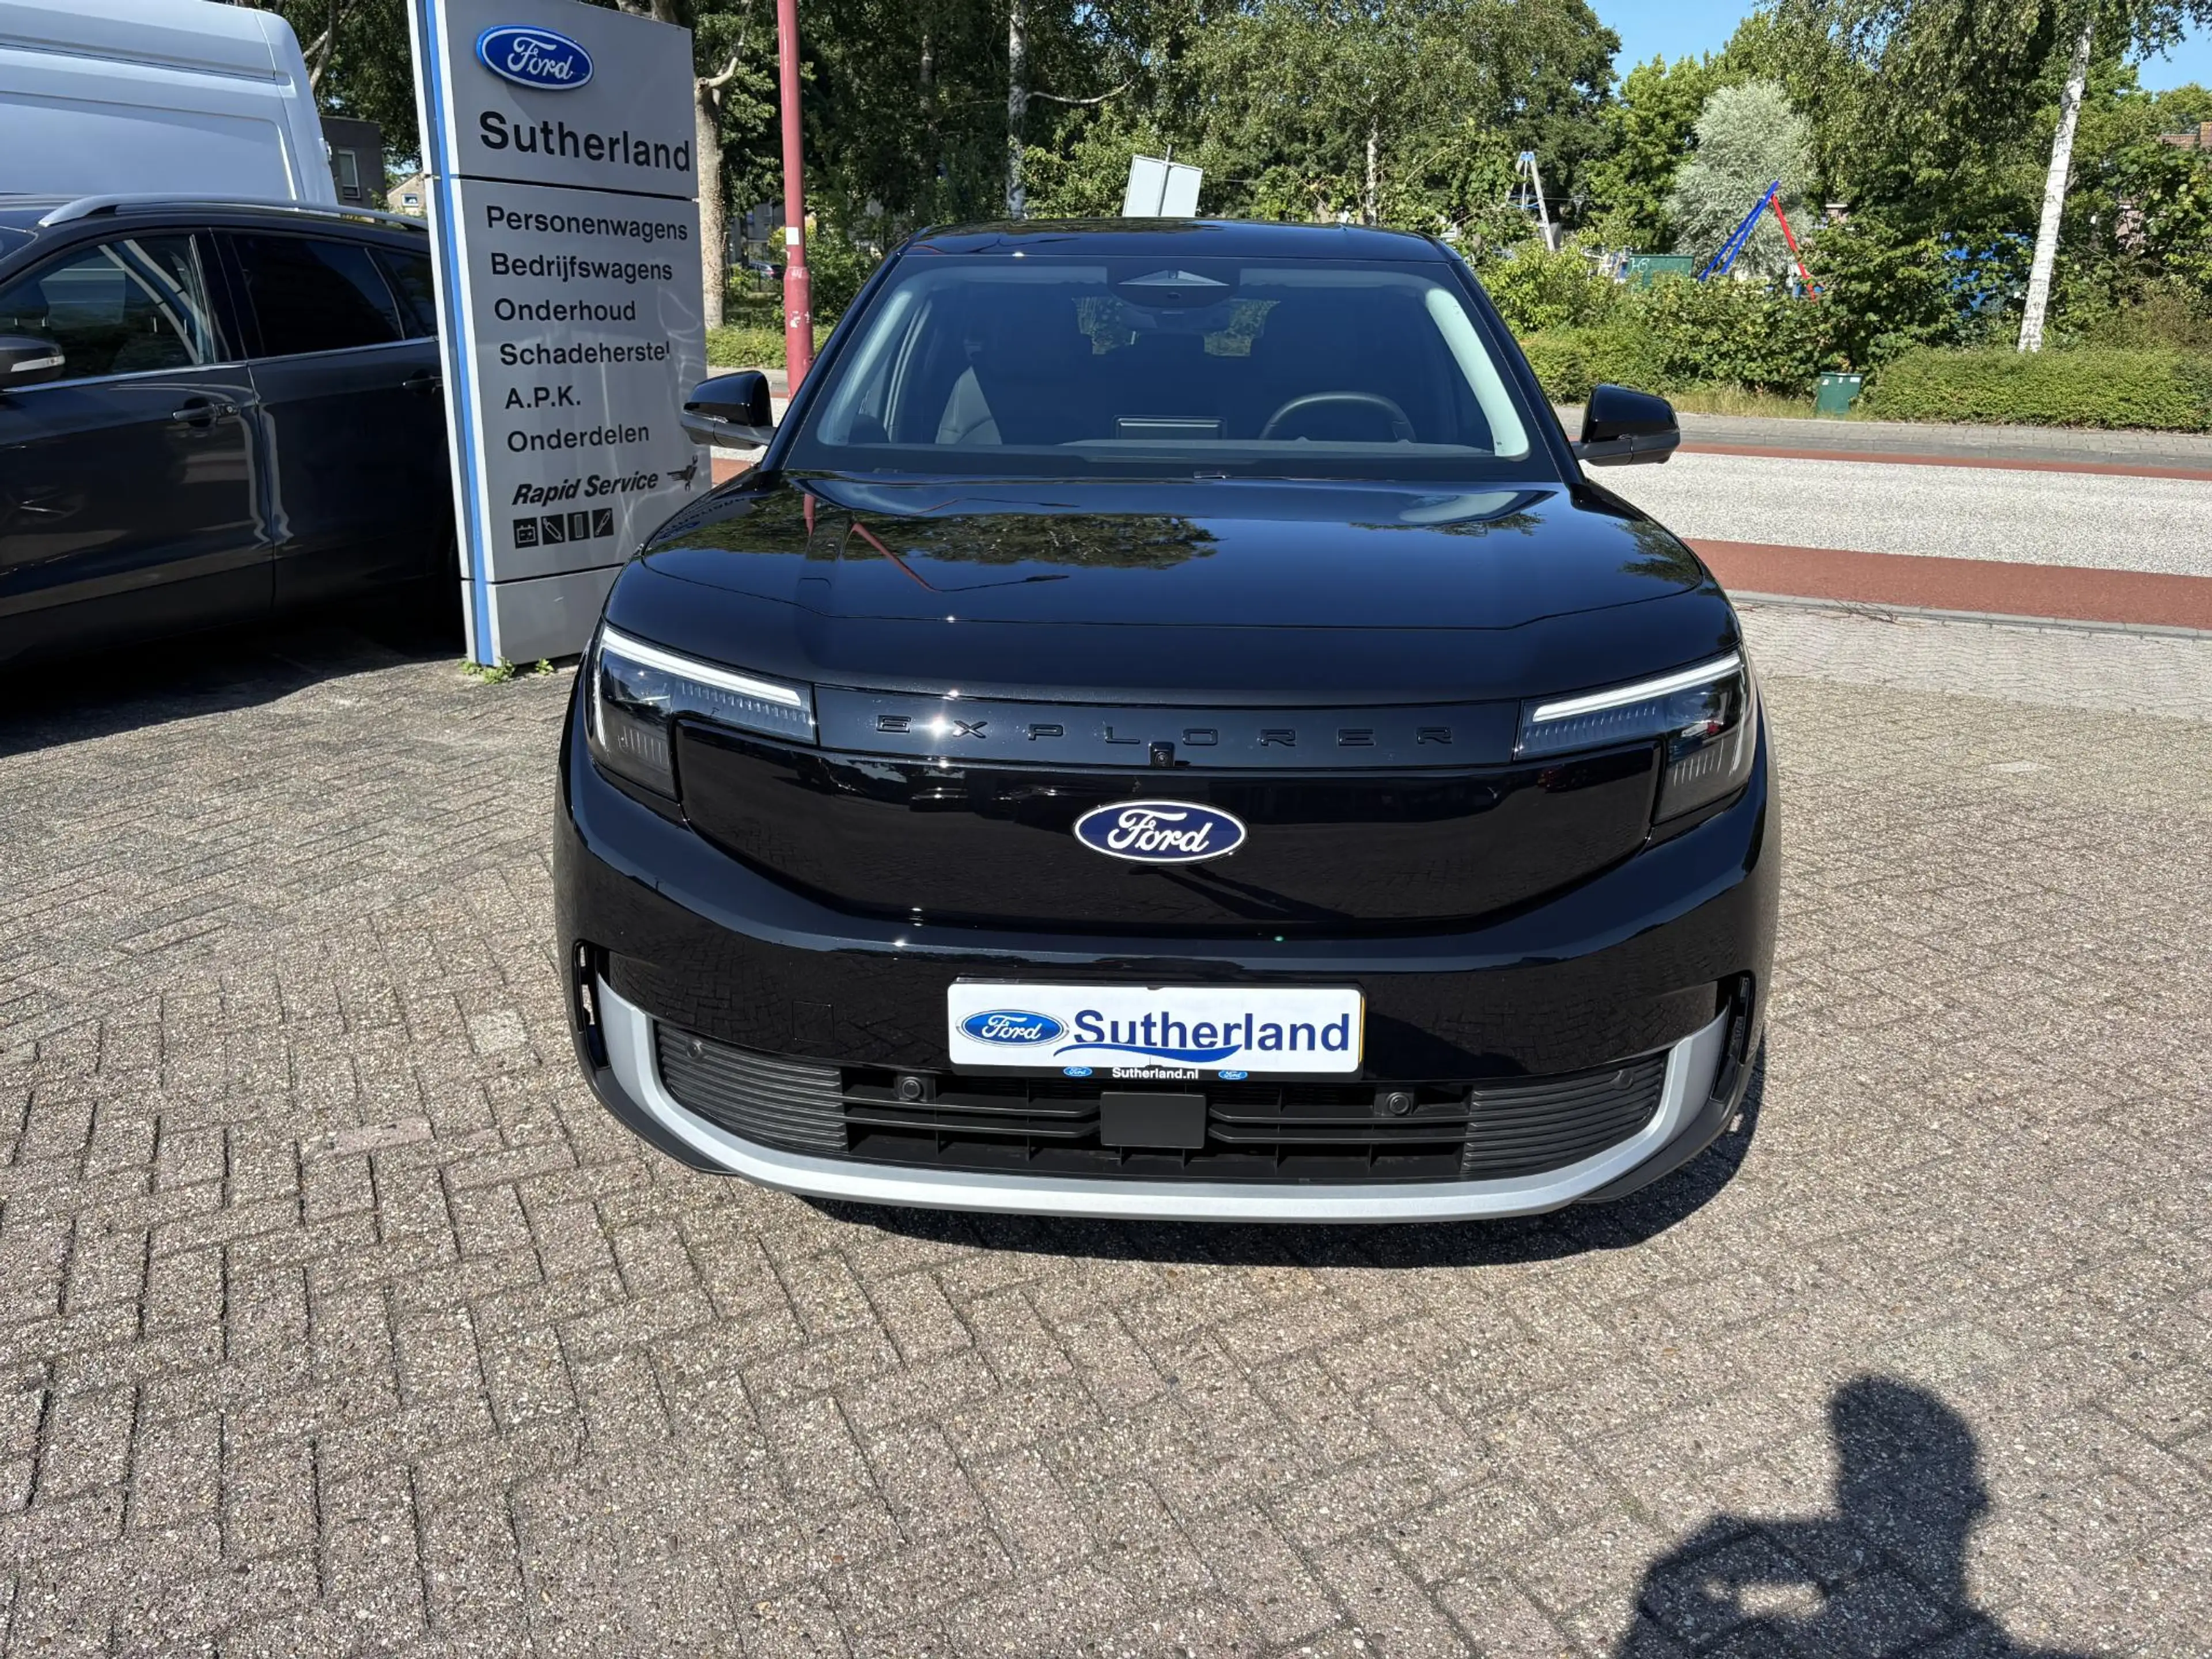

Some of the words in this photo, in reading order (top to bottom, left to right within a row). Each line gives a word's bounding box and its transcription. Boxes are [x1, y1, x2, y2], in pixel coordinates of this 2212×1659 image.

[507, 37, 573, 79] Ford
[480, 111, 690, 172] Sutherland
[487, 206, 688, 243] Personenwagens
[491, 252, 673, 283] Bedrijfswagens
[494, 298, 636, 321] Onderhoud
[499, 341, 670, 366] Schadeherstel
[505, 385, 581, 409] A.P.K.
[507, 424, 649, 452] Onderdelen
[512, 479, 581, 507] Rapid
[584, 471, 659, 498] Service
[876, 714, 1453, 747] EXPLORER
[1107, 809, 1209, 853] Ford
[982, 1015, 1043, 1040] Ford
[1074, 1010, 1350, 1052] Sutherland
[1112, 1067, 1199, 1080] Sutherland.nl
